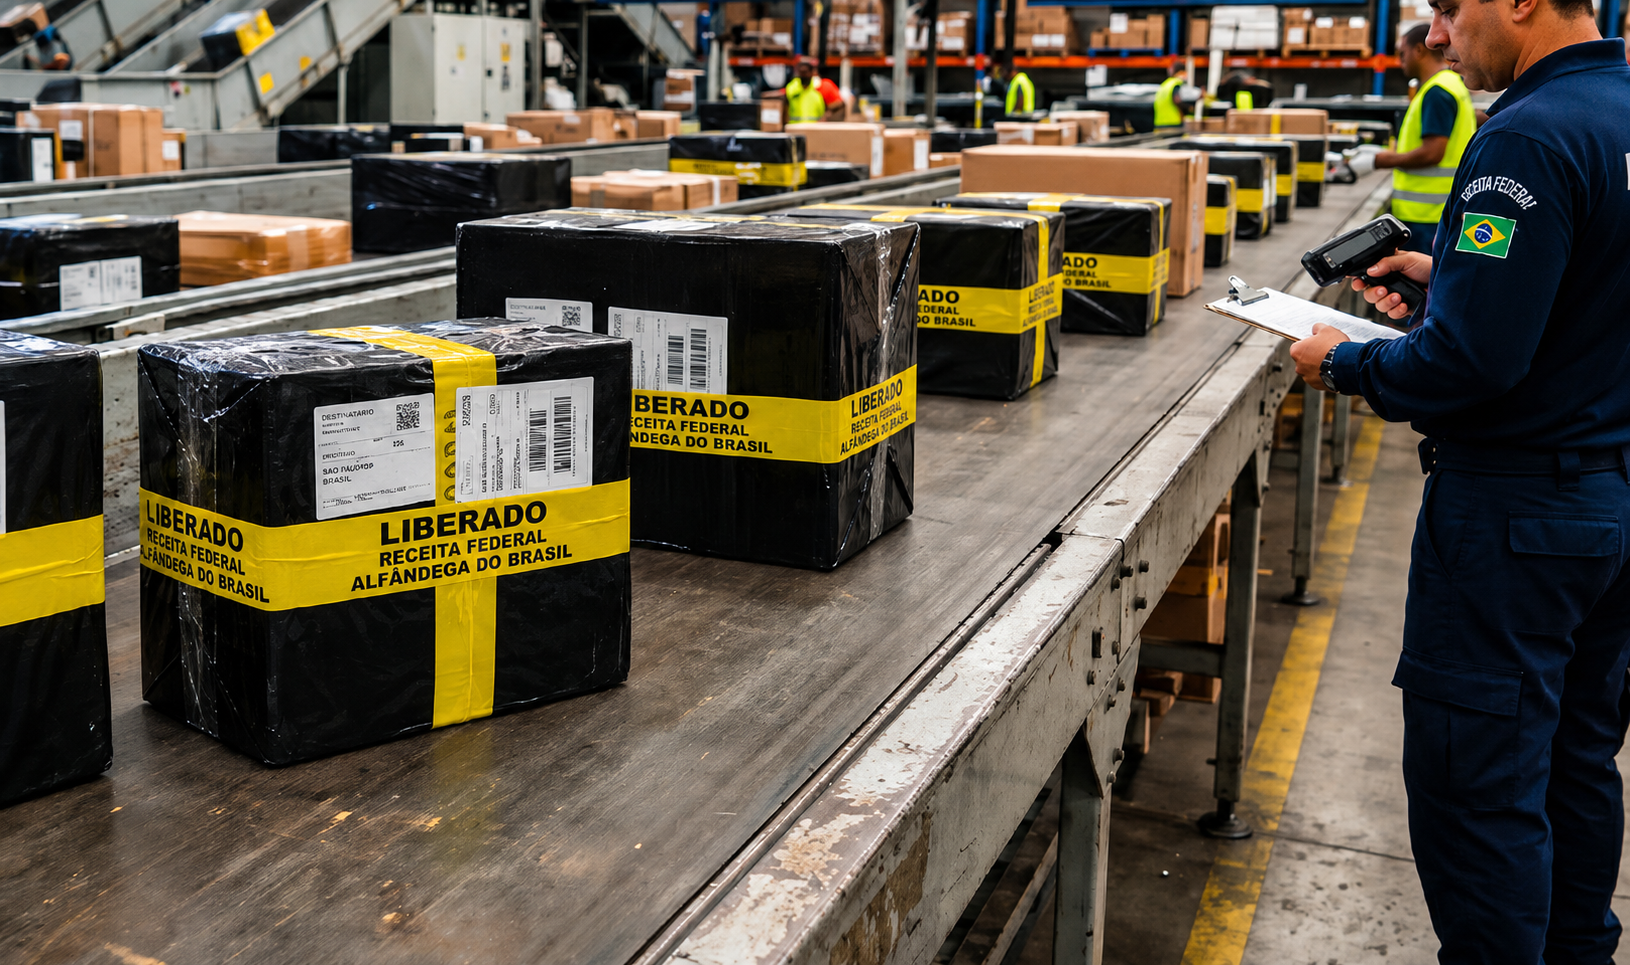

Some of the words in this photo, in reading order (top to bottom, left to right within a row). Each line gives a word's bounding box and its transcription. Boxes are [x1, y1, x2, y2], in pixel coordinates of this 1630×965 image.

[934, 316, 976, 327] BRASIL
[634, 395, 750, 420] BERADO
[851, 378, 903, 418] LIBERADO
[680, 421, 749, 436] FEDERAL
[686, 436, 708, 448] DO
[714, 438, 773, 454] BRASIL
[147, 500, 243, 552] LIBERADO
[381, 500, 547, 546] LIBERADO
[147, 527, 188, 556] RECEITA
[191, 544, 245, 576] FEDERAL
[379, 542, 461, 567] RECEITA
[467, 529, 547, 554] FEDERAL
[198, 567, 214, 585] DO
[219, 573, 270, 603] BRASIL
[351, 560, 470, 592] ALFÂNDEGA
[476, 555, 502, 572] DO
[508, 544, 573, 567] BRASIL
